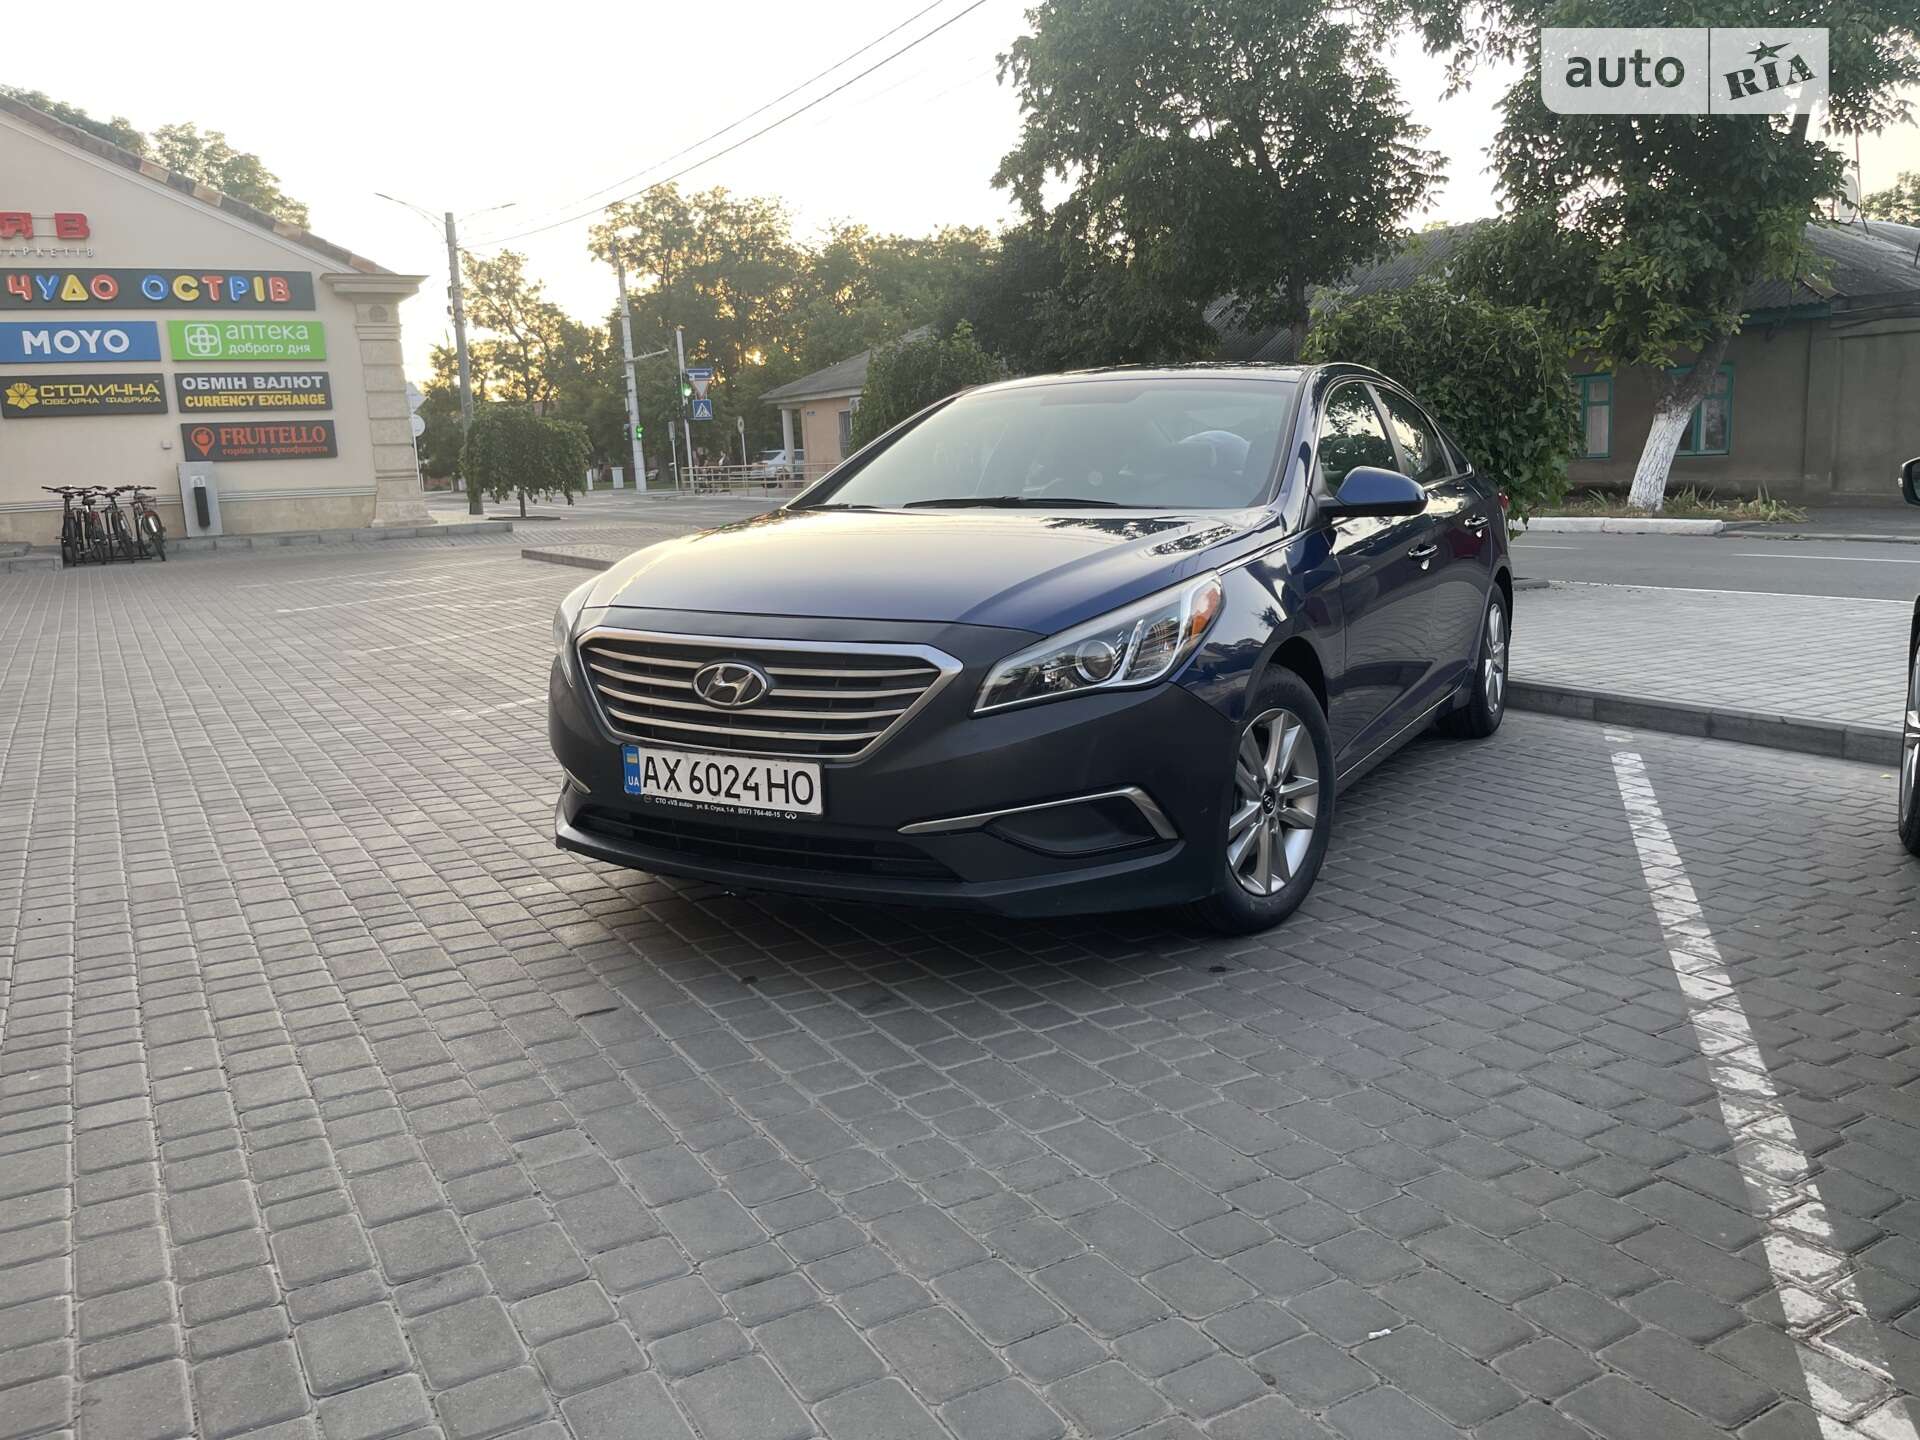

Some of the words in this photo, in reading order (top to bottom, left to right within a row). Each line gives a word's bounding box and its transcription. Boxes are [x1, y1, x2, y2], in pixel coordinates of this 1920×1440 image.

[7, 273, 119, 301] ЧУДО
[141, 274, 291, 302] ОСТРІВ
[226, 323, 309, 340] аптека
[22, 329, 130, 355] MOYO
[228, 342, 284, 355] доброго
[287, 344, 311, 355] дня
[182, 376, 248, 390] ОБМІН
[253, 375, 323, 389] ВАЛЮТ
[40, 383, 160, 397] СТОЛИЧНА
[105, 396, 162, 404] ФАБРИКА
[185, 394, 255, 407] CURRENCY
[258, 393, 327, 406] EXCHANGE
[220, 425, 326, 445] FRUITELLO
[628, 776, 639, 786] UA
